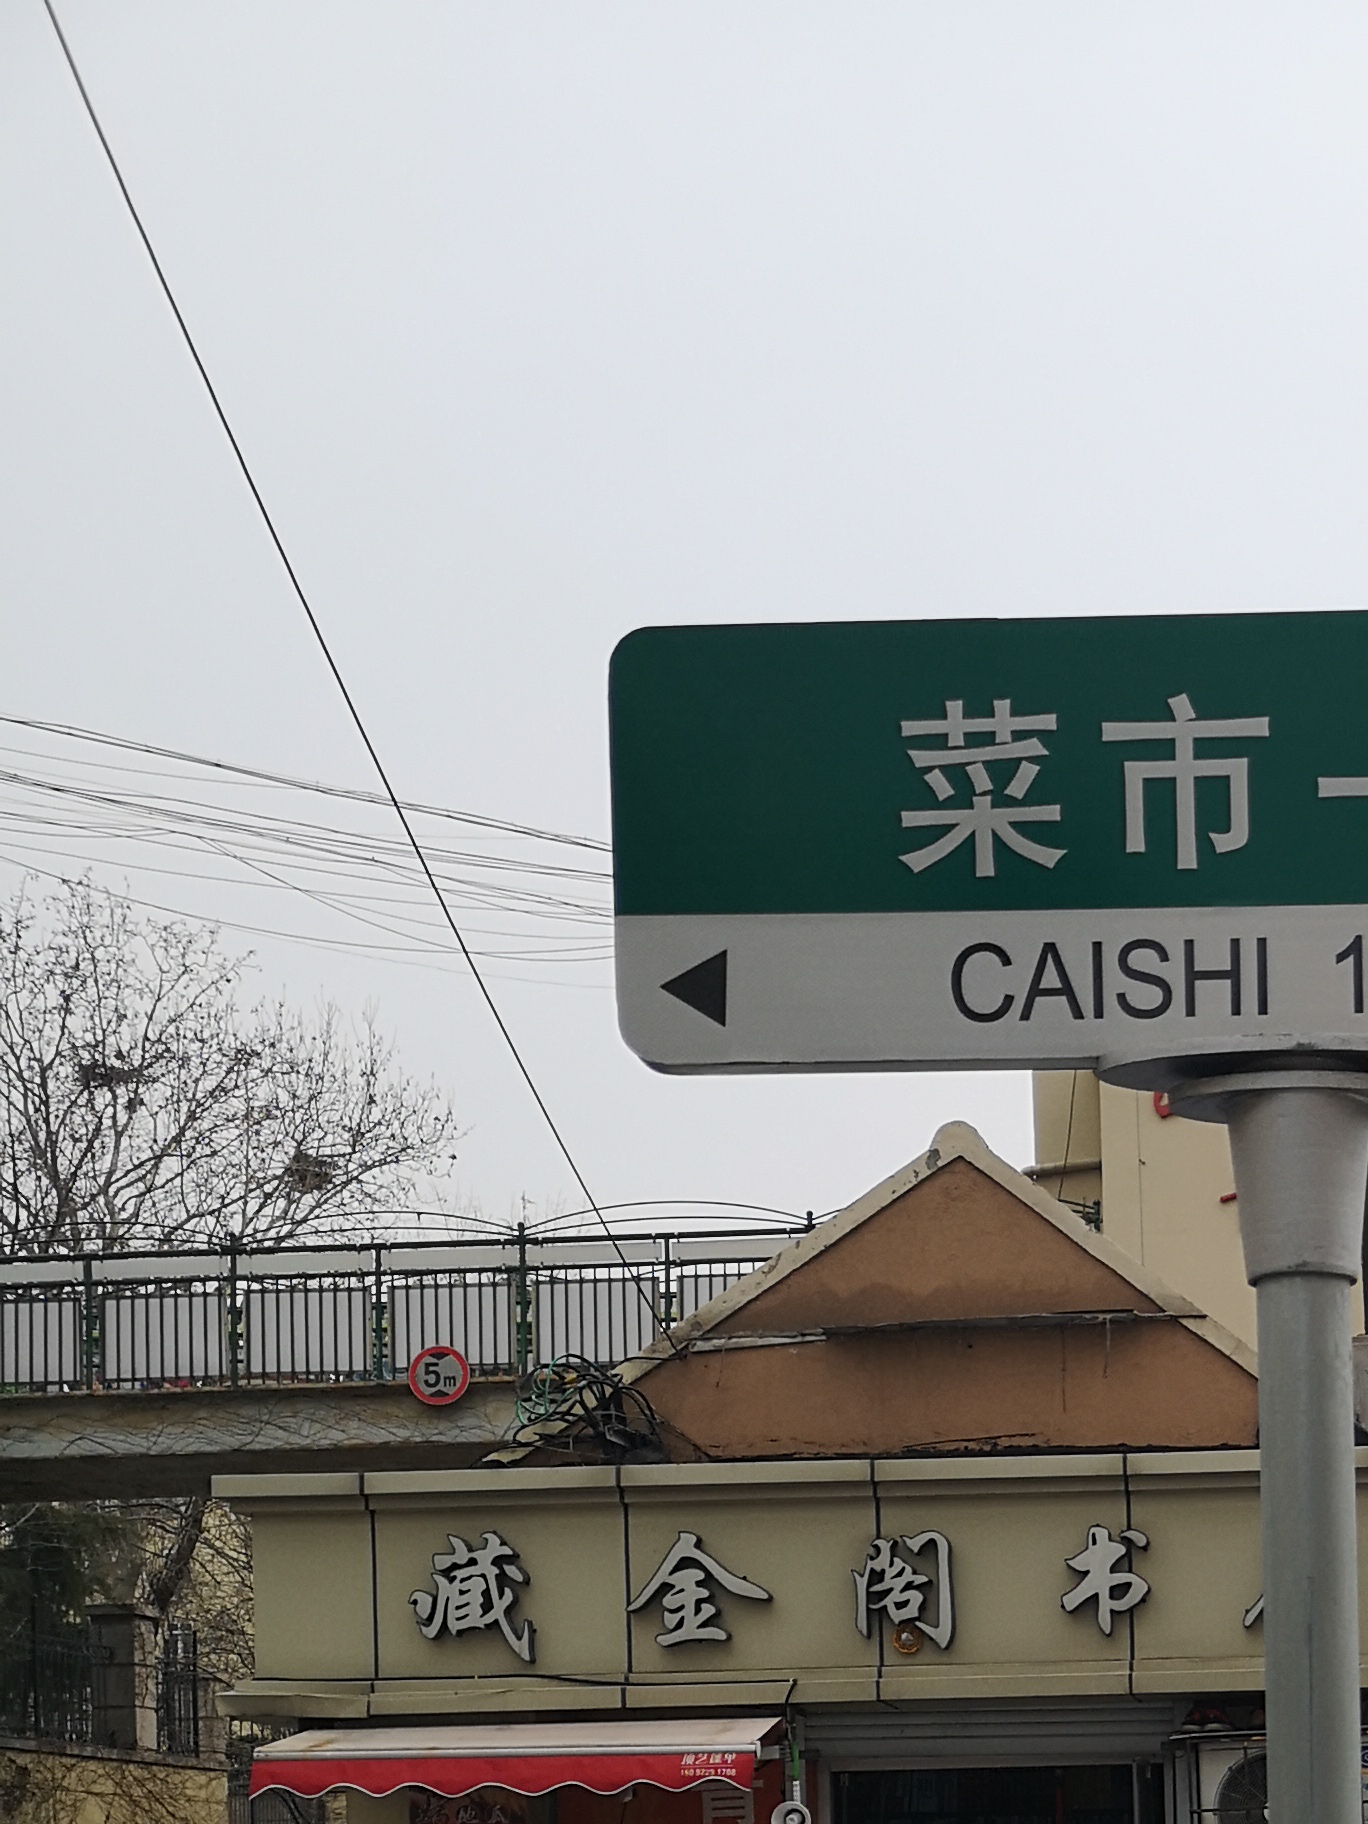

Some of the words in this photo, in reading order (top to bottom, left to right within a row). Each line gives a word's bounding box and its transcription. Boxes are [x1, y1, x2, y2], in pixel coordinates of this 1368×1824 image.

[949, 937, 1271, 1026] CAISHI
[408, 1524, 1264, 1663] 藏金阁书
